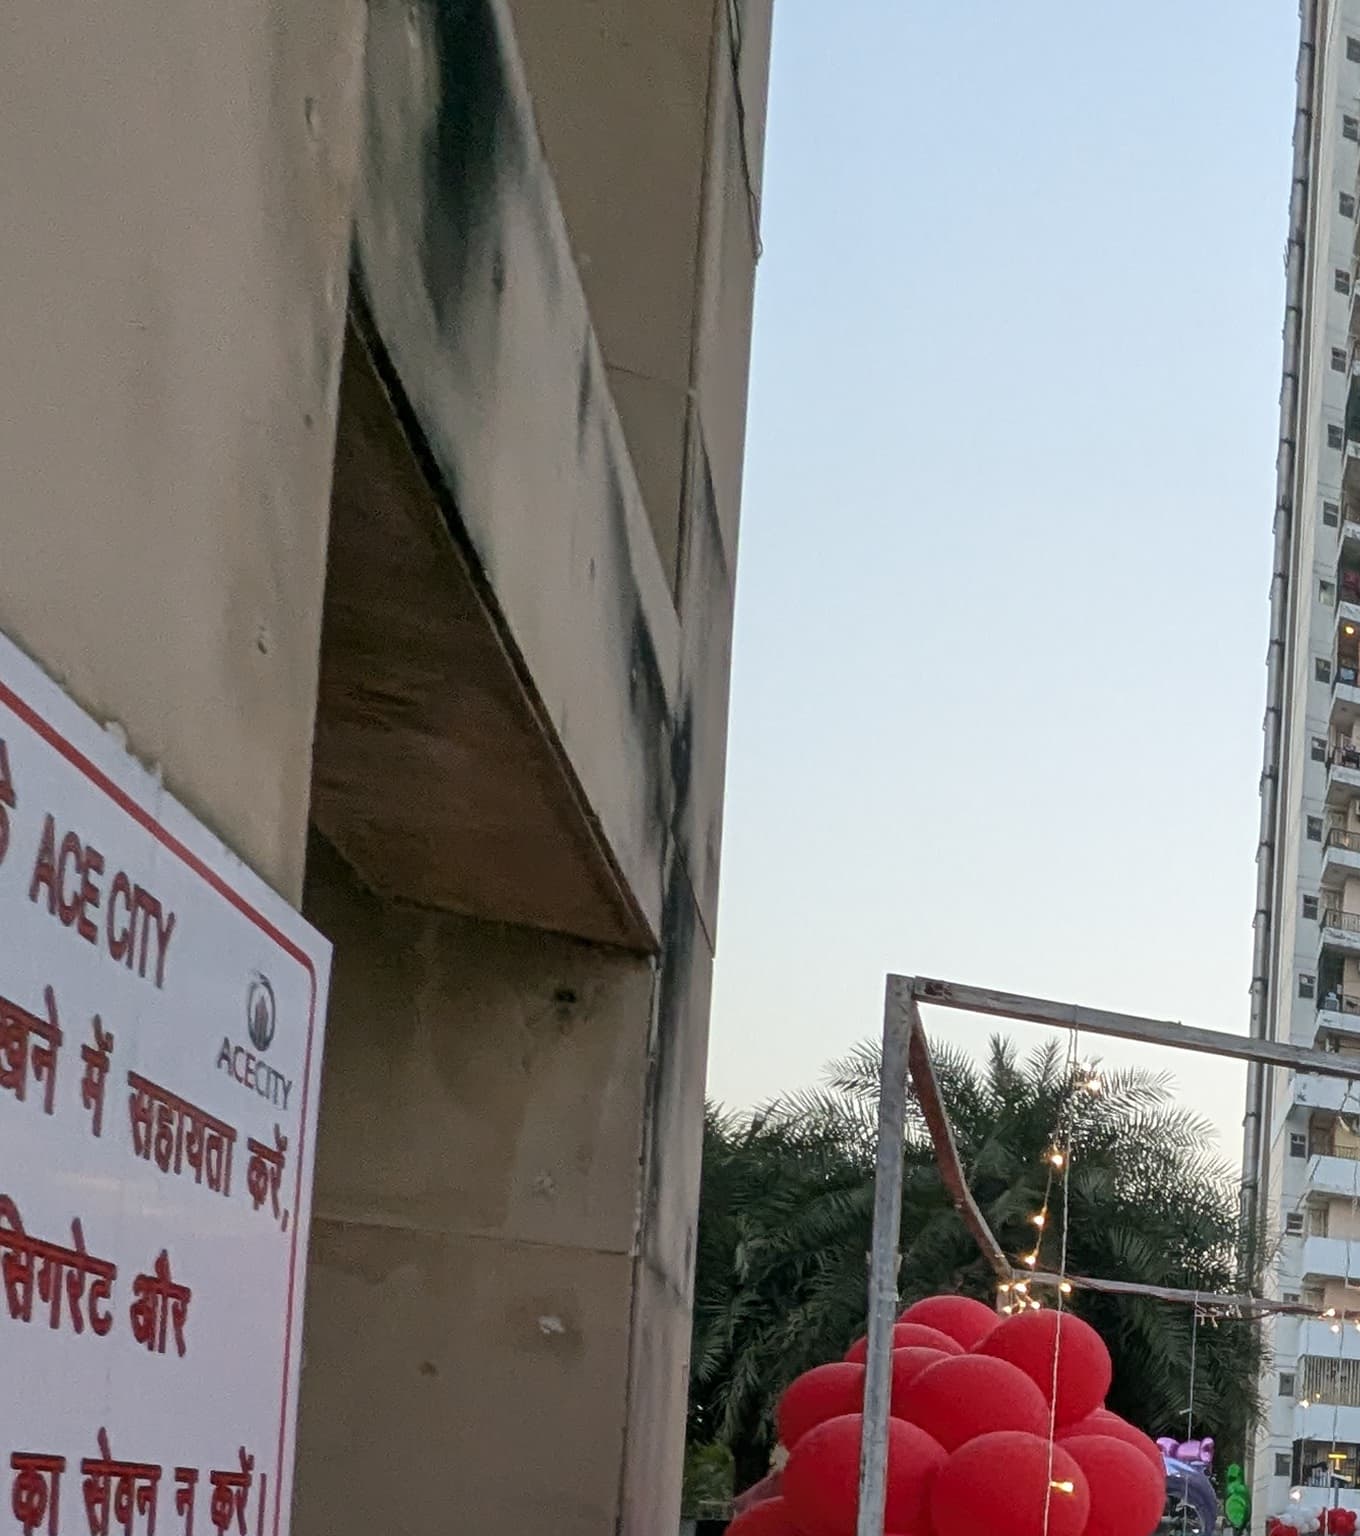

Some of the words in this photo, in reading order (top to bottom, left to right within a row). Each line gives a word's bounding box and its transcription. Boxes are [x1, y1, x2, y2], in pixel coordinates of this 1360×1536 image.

[29, 812, 104, 945] ACE
[107, 871, 175, 989] CITY
[81, 1014, 113, 1137] में
[128, 1070, 237, 1197] सहायता
[217, 1036, 292, 1110] ACECITY
[130, 1248, 192, 1357] और
